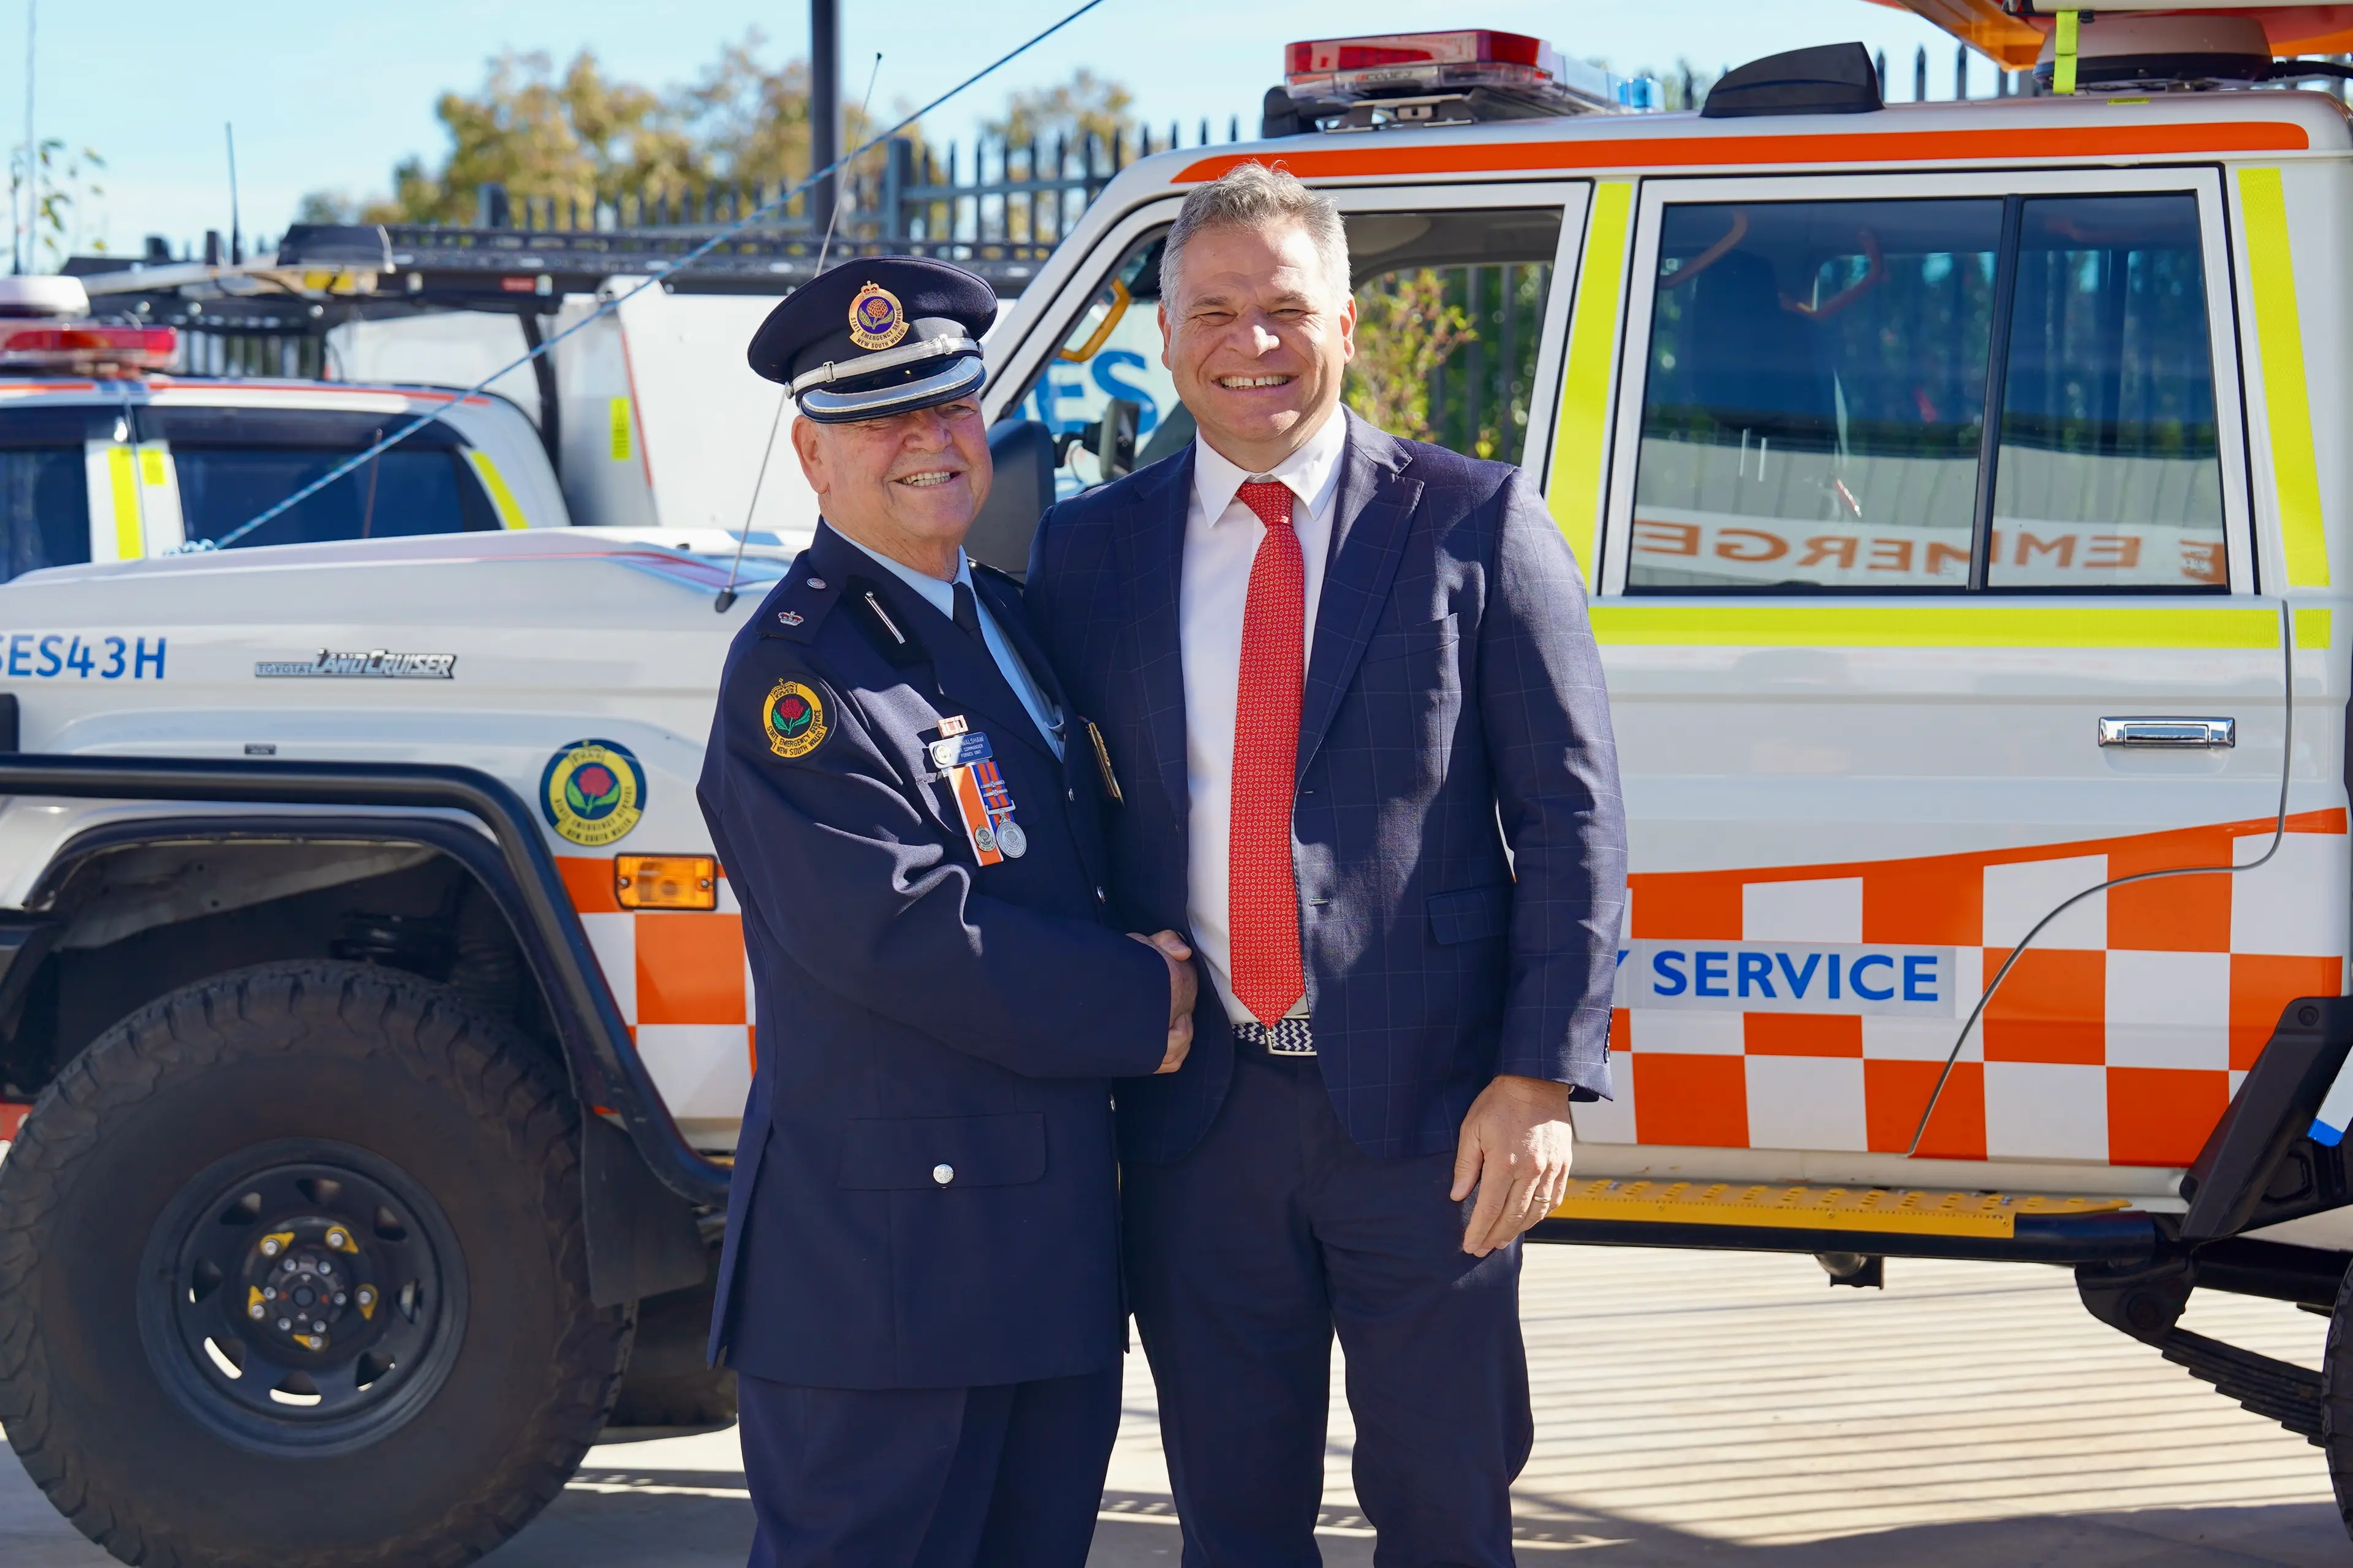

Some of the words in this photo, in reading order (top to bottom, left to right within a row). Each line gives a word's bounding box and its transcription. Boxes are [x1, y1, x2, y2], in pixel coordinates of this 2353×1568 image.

[851, 317, 862, 333] STATE
[861, 330, 893, 341] EMERGENCY
[893, 307, 901, 331] SERVICE
[857, 338, 870, 347] NEW
[890, 328, 905, 344] WALES
[0, 634, 167, 680] ES43H
[258, 664, 306, 675] TOYOTA
[776, 746, 788, 754] NEW
[789, 744, 808, 756] SOUTH
[808, 731, 824, 746] WALES
[779, 733, 811, 747] EMERGENCY
[809, 710, 821, 734] SERVICE
[1653, 950, 1938, 1002] SERVICE
